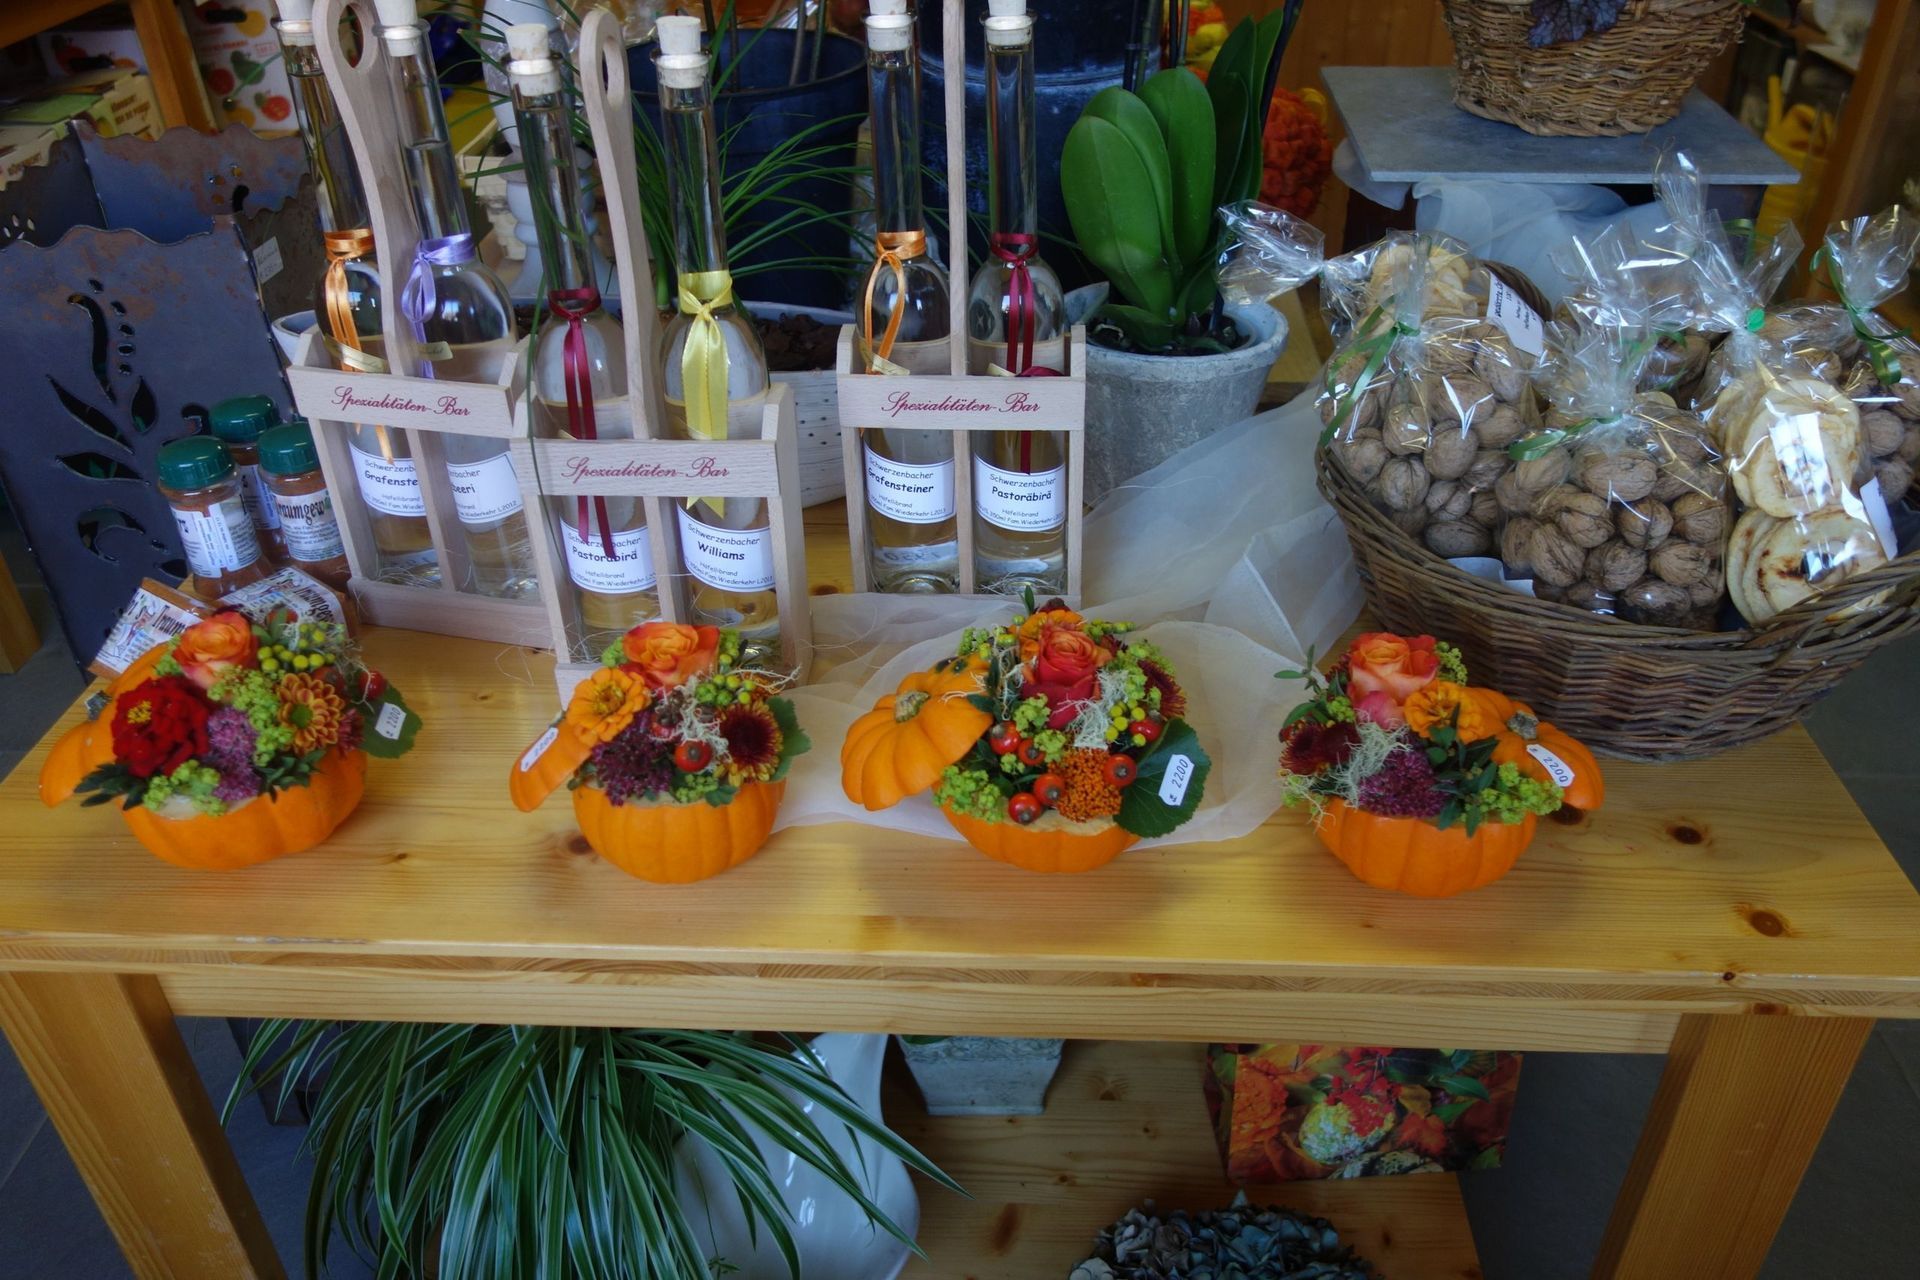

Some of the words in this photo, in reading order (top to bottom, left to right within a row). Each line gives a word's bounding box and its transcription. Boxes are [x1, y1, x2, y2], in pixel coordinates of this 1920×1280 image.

[331, 385, 470, 416] Spezialitäten-Bar
[881, 391, 1040, 418] Spezialitäten-Bar
[561, 456, 730, 484] Spezialitäten-Bar
[868, 467, 934, 493] Grafensteiner
[990, 473, 1057, 488] Schwerzenbacher
[688, 523, 760, 546] Schwerzenbacher
[697, 541, 745, 561] Williams
[1543, 756, 1569, 782] 2200
